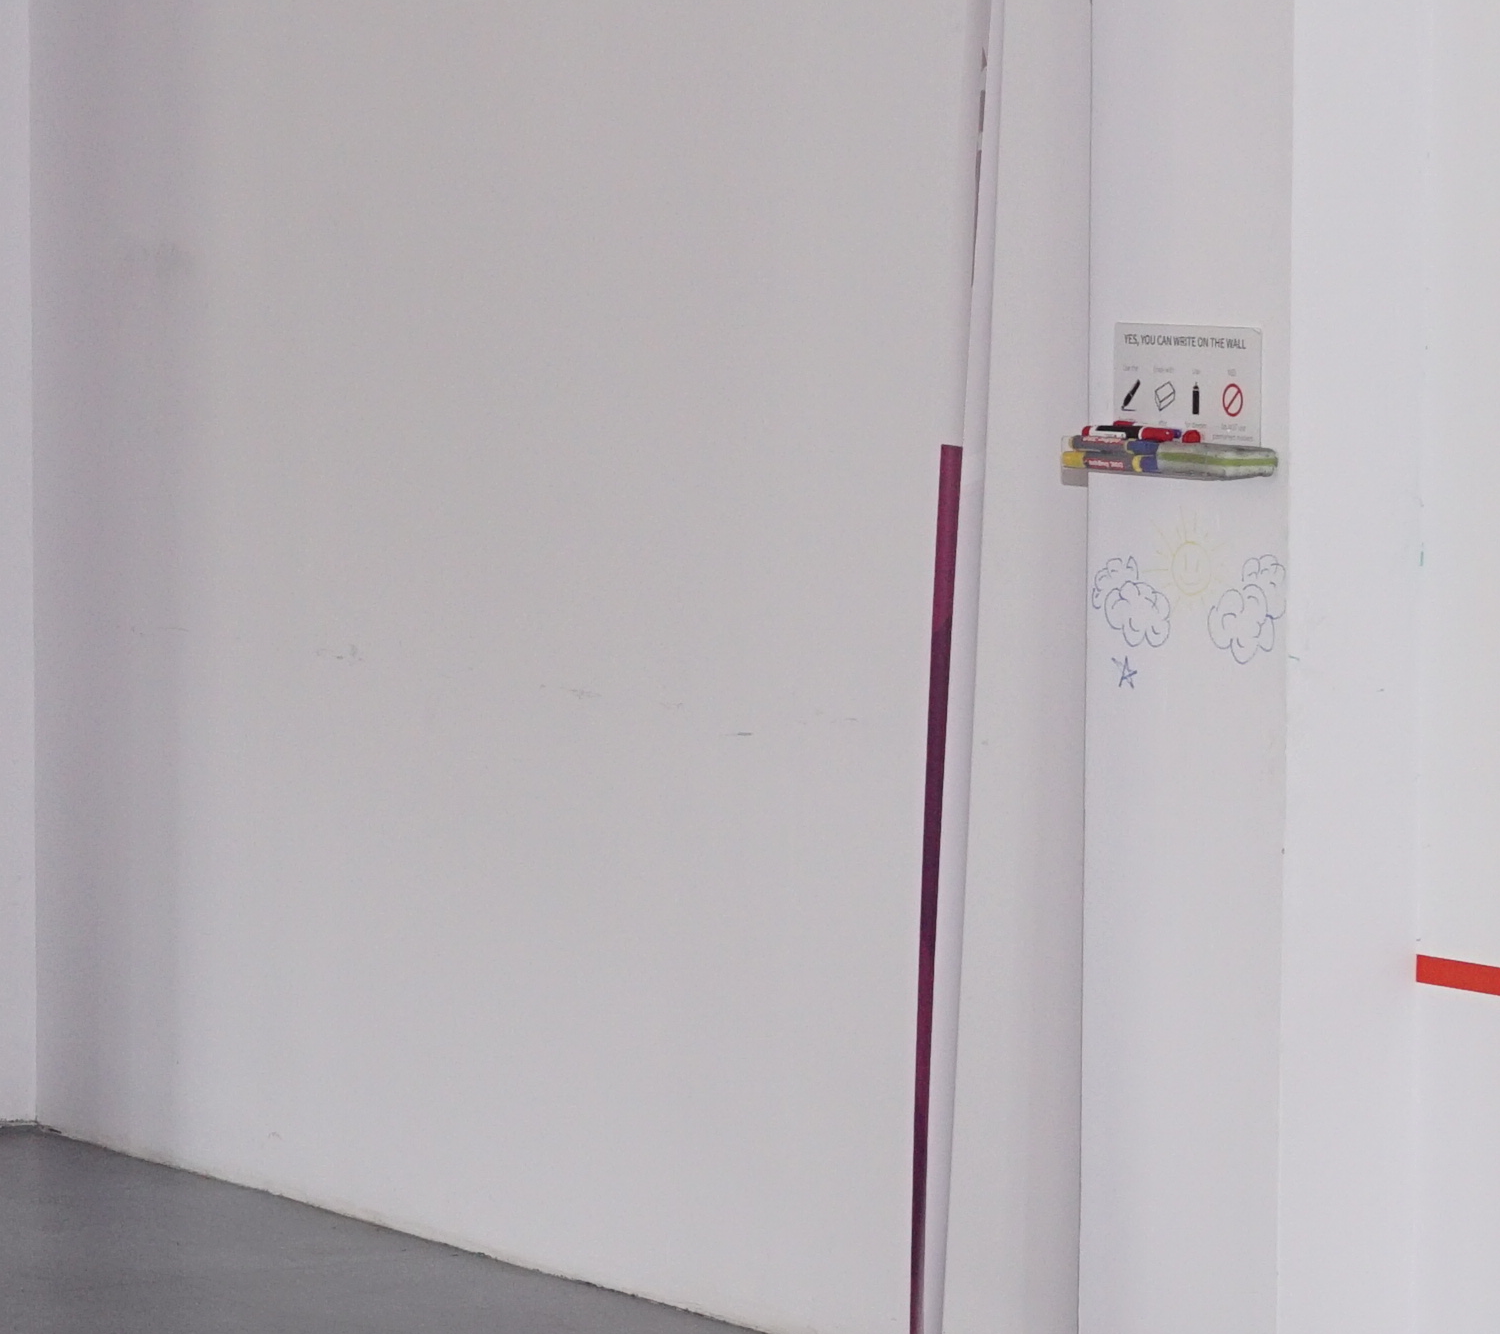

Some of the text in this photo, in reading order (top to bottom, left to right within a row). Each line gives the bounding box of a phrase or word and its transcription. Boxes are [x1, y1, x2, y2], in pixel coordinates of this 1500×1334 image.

[1124, 334, 1246, 349] YES, YOU CAN WRITE ON THE WALL
